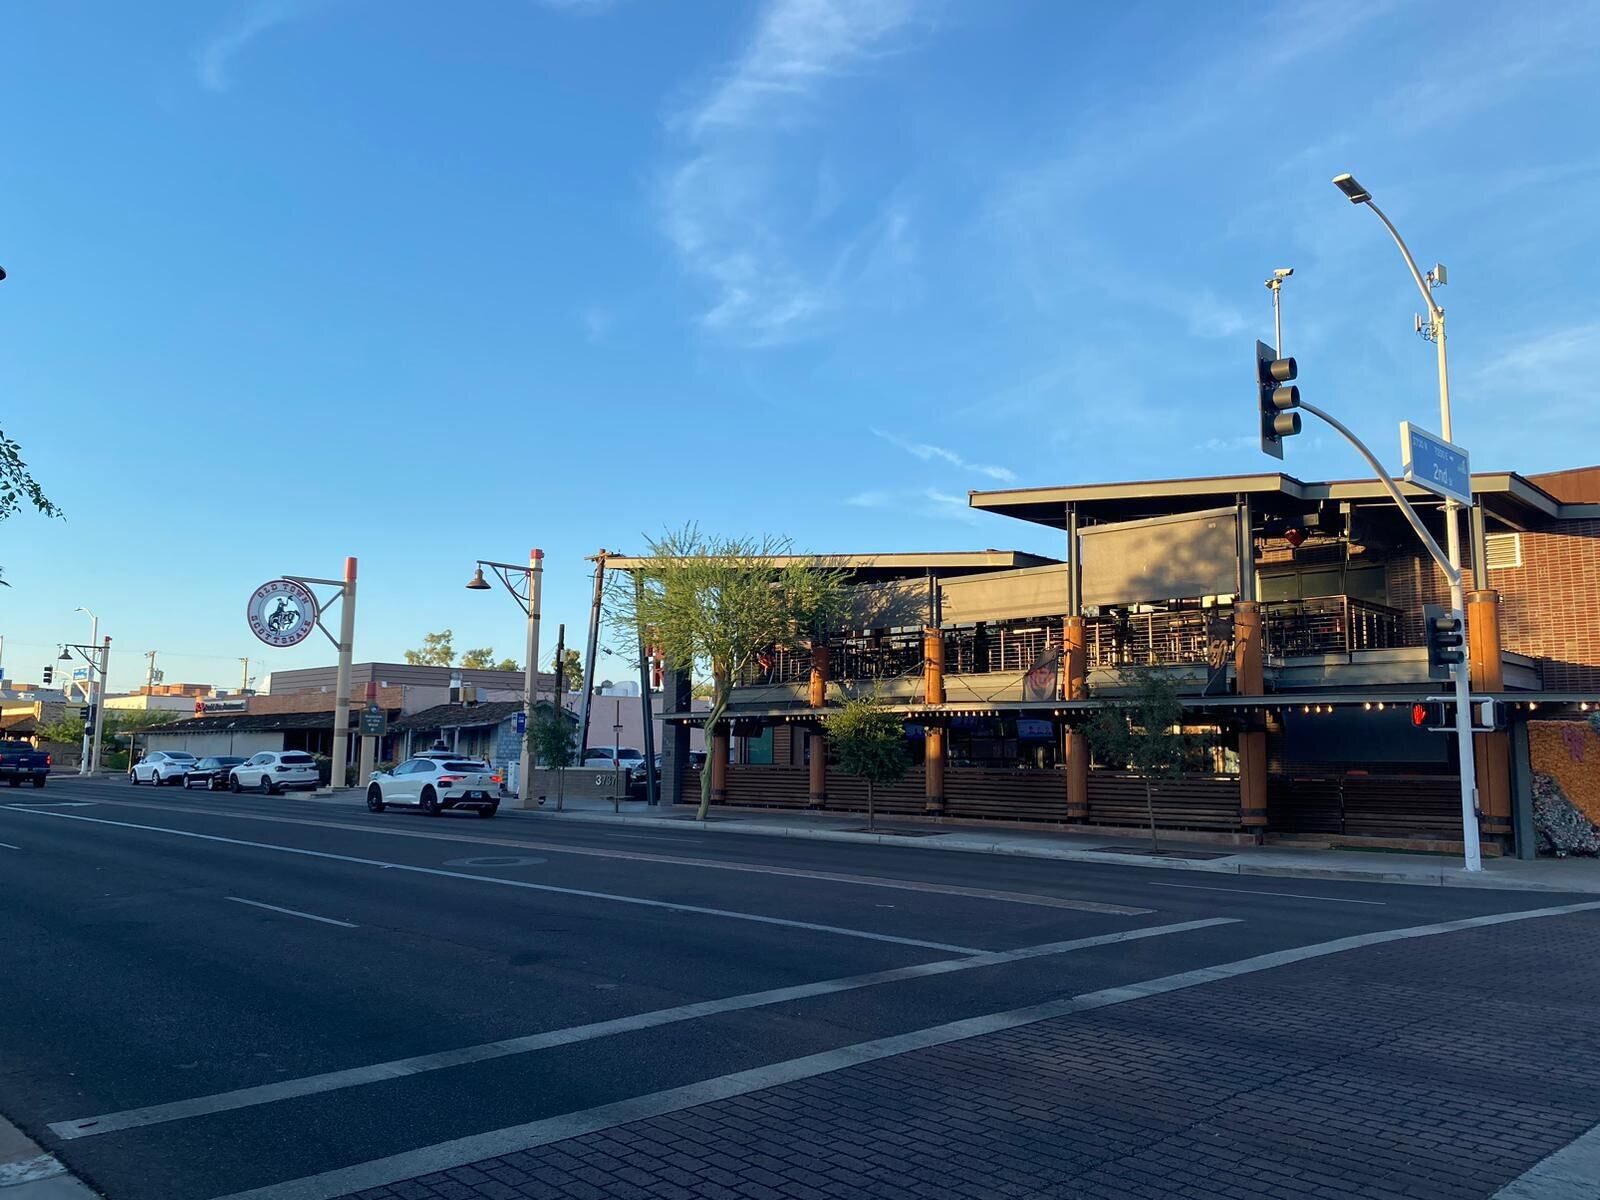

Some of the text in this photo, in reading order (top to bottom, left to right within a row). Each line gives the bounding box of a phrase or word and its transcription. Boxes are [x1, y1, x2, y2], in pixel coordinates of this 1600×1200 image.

[1433, 462, 1448, 484] 2nd
[257, 583, 310, 605] OLD TOWN
[251, 614, 311, 645] SCOTTSDALE
